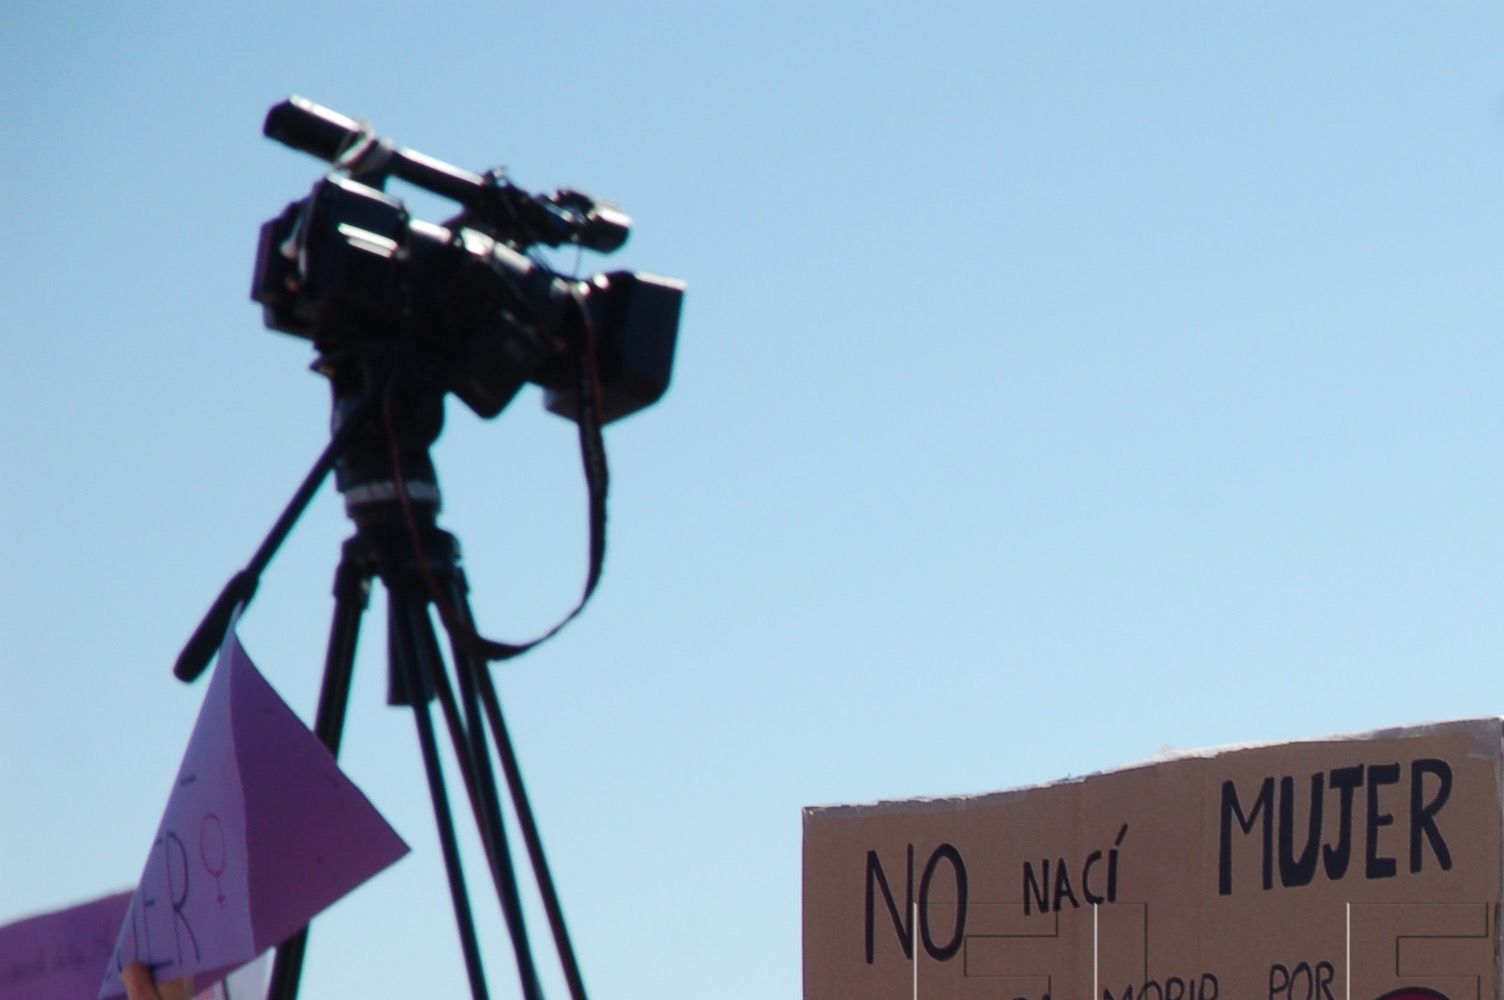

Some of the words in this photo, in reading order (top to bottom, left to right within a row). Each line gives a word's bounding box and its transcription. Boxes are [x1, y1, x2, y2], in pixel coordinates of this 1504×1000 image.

[863, 843, 968, 964] NO
[1022, 824, 1129, 916] NACÍ
[1218, 758, 1454, 896] MUJER
